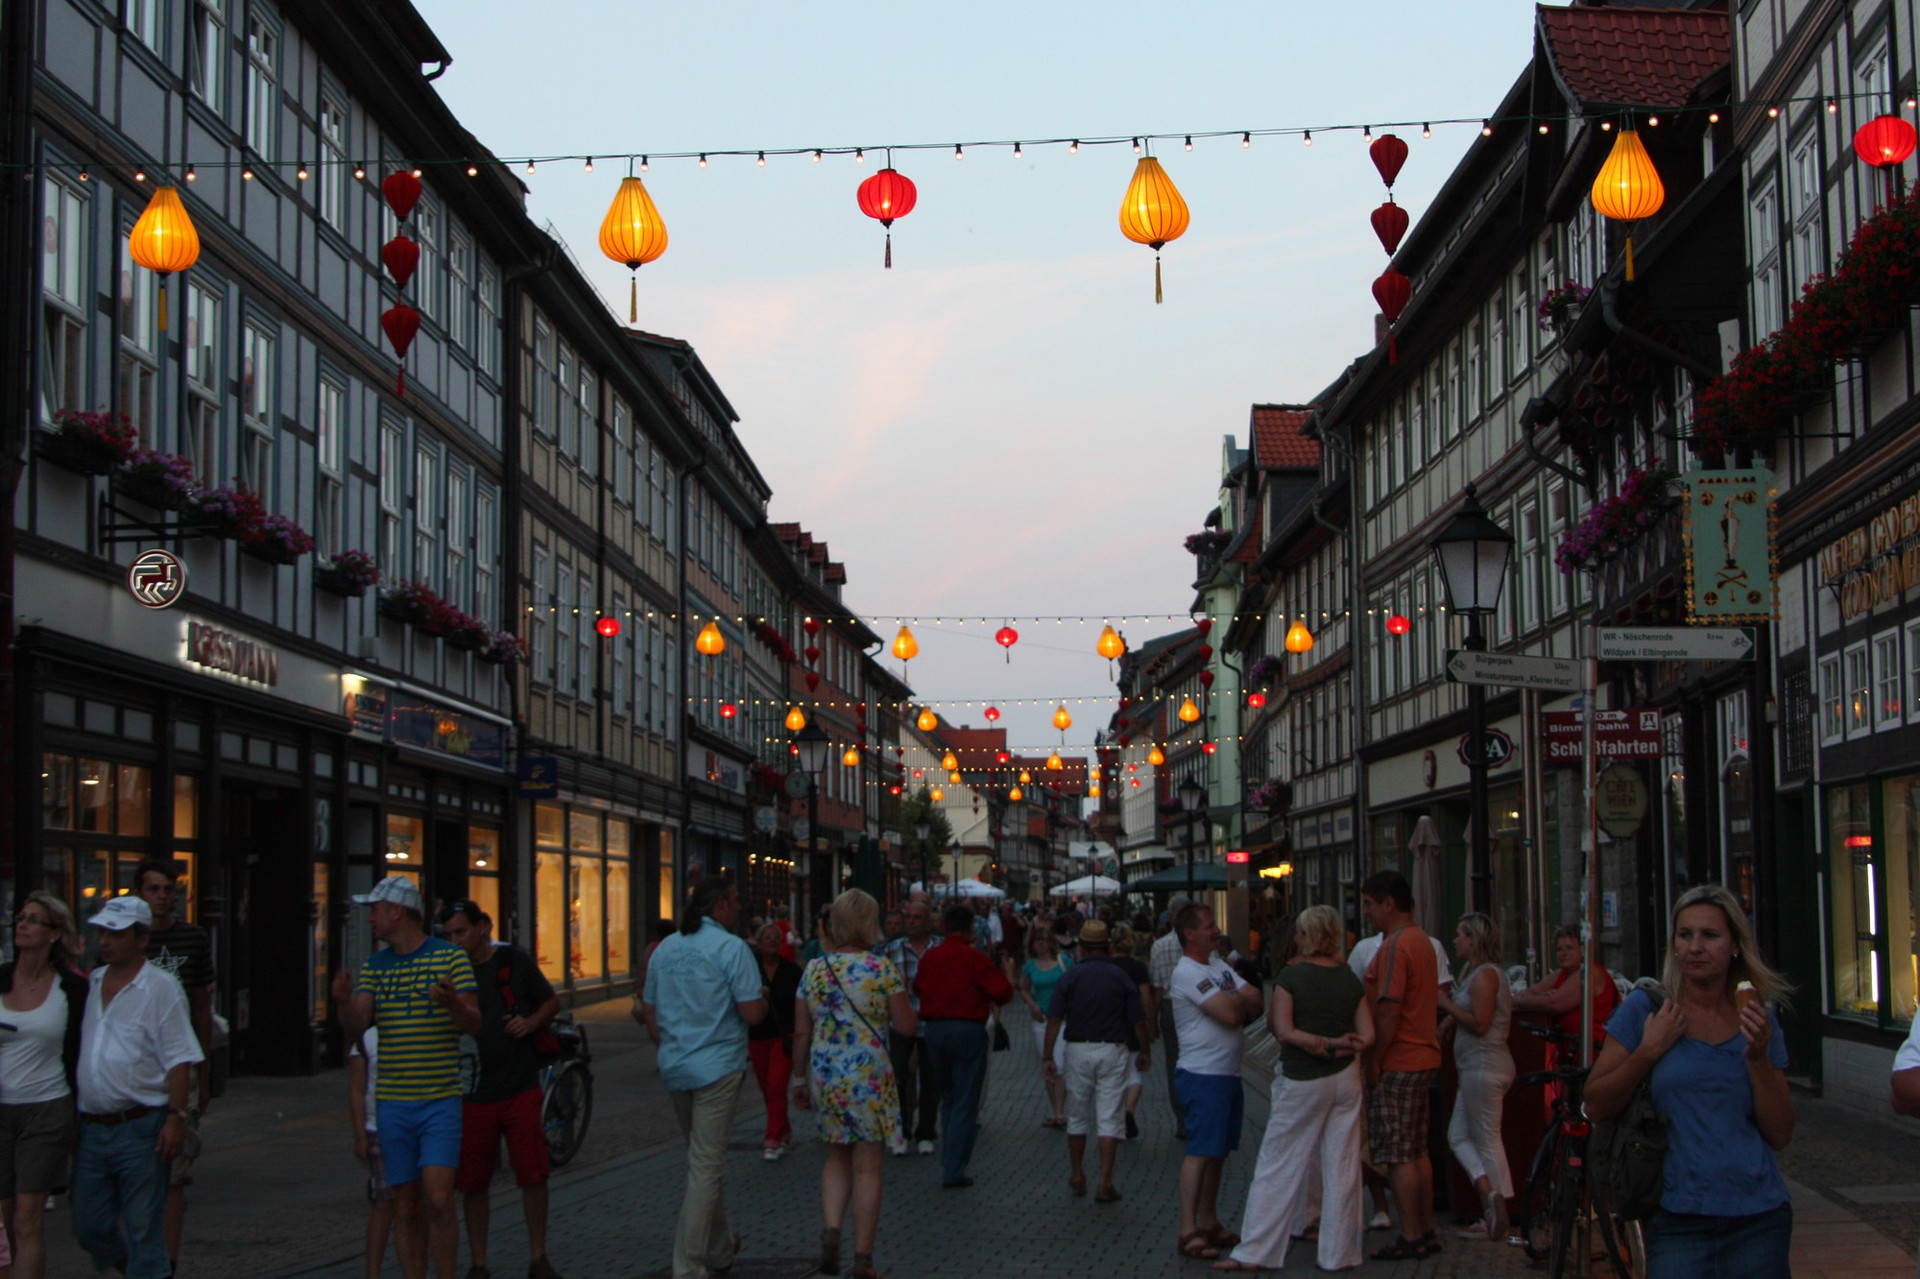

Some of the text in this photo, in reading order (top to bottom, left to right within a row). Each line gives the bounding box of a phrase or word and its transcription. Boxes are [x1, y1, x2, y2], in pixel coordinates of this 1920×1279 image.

[1819, 526, 1868, 586] ALFRED
[1603, 632, 1617, 641] WR
[1623, 632, 1674, 641] Nöschenrode
[1603, 648, 1637, 657] Wildpark
[1642, 648, 1689, 657] Elbingerode
[1476, 654, 1513, 666] Bürgerpark
[1476, 670, 1525, 683] Miniaturenpark
[1549, 722, 1630, 733] Bimmbahn
[1550, 739, 1658, 757] Schlßfahrten
